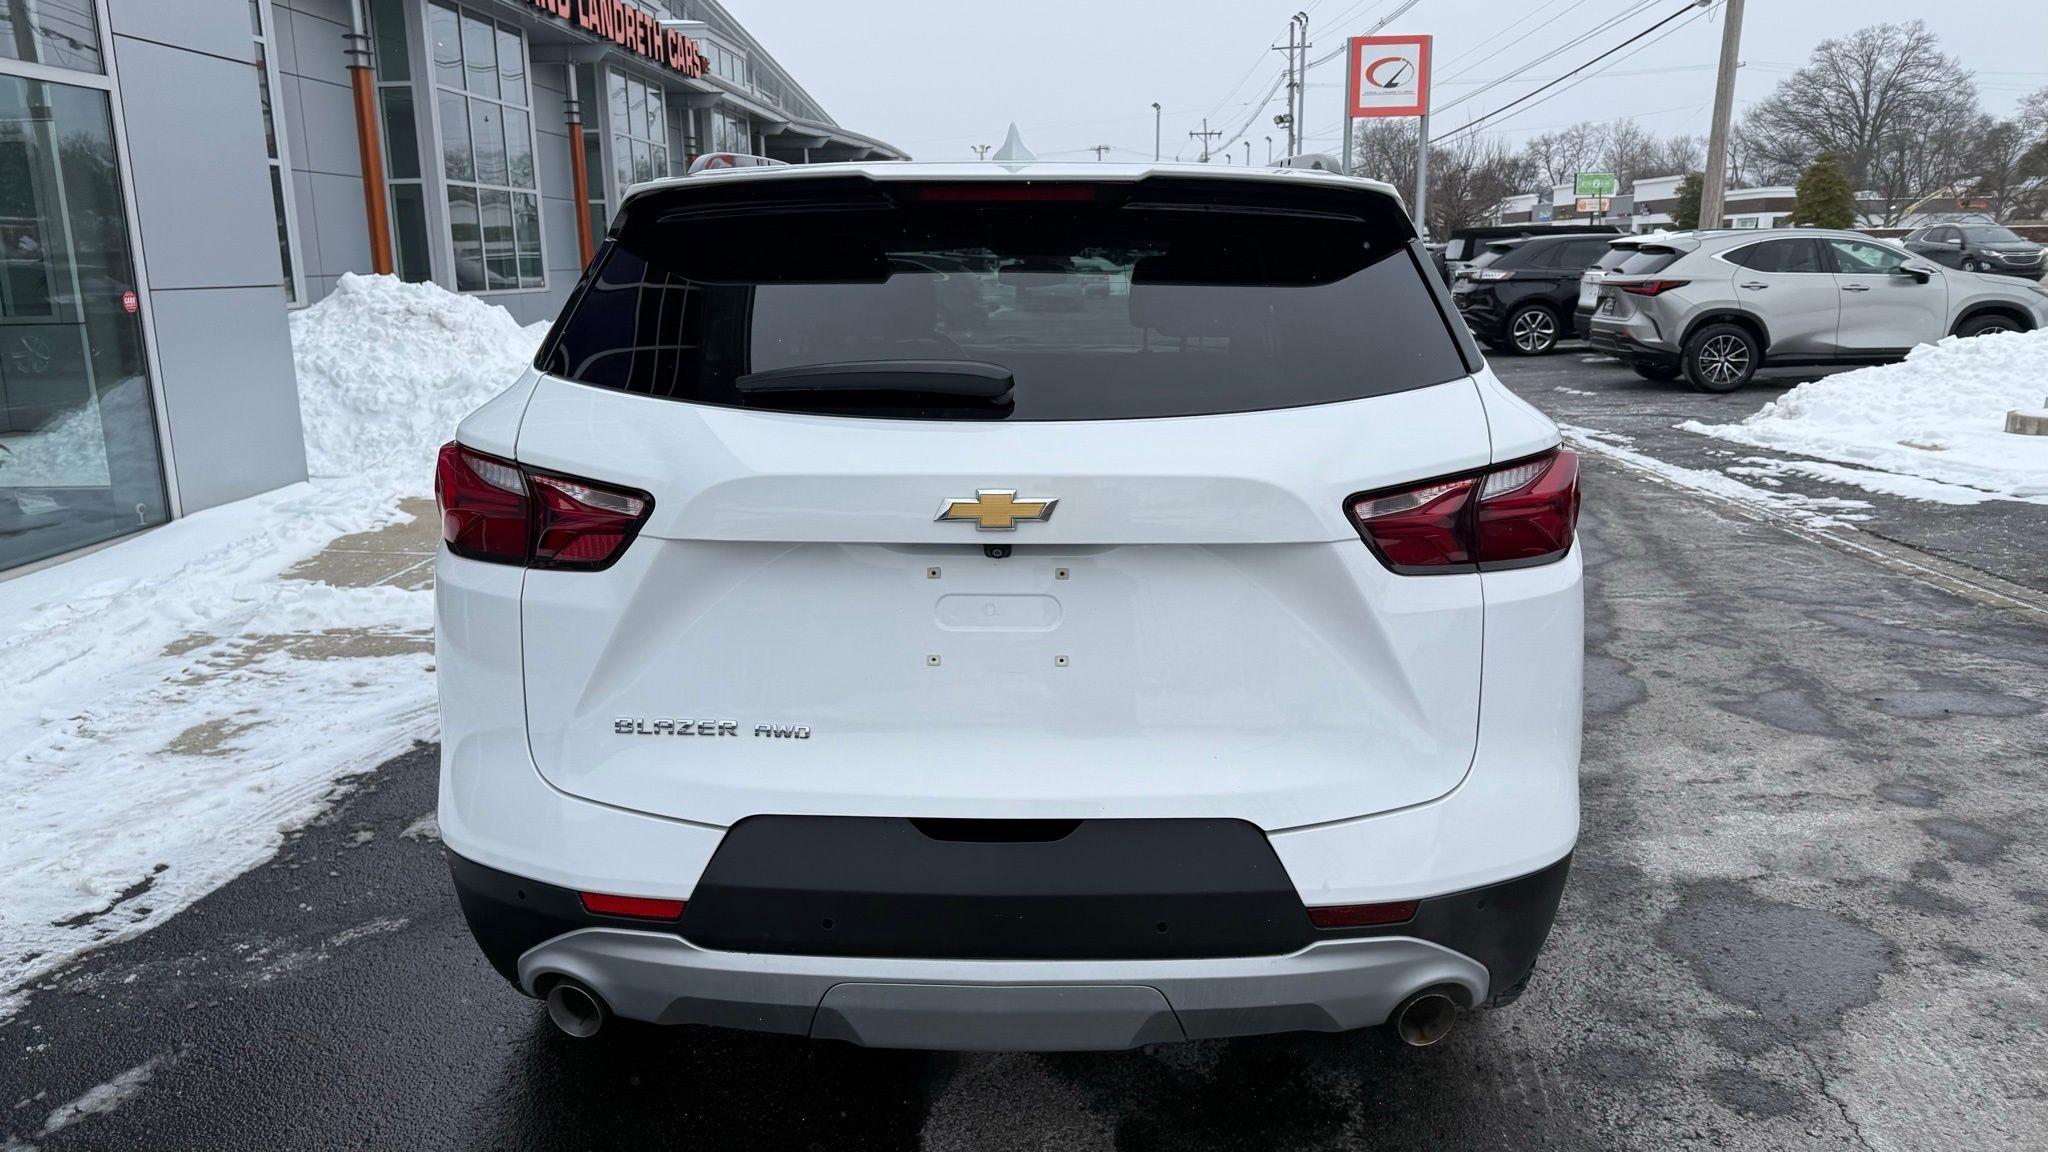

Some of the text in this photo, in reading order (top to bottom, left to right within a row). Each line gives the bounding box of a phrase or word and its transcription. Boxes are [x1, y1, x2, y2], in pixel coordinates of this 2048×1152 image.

[578, 0, 702, 79] LANDRETH CARS
[614, 717, 811, 739] BLAZER AWD
